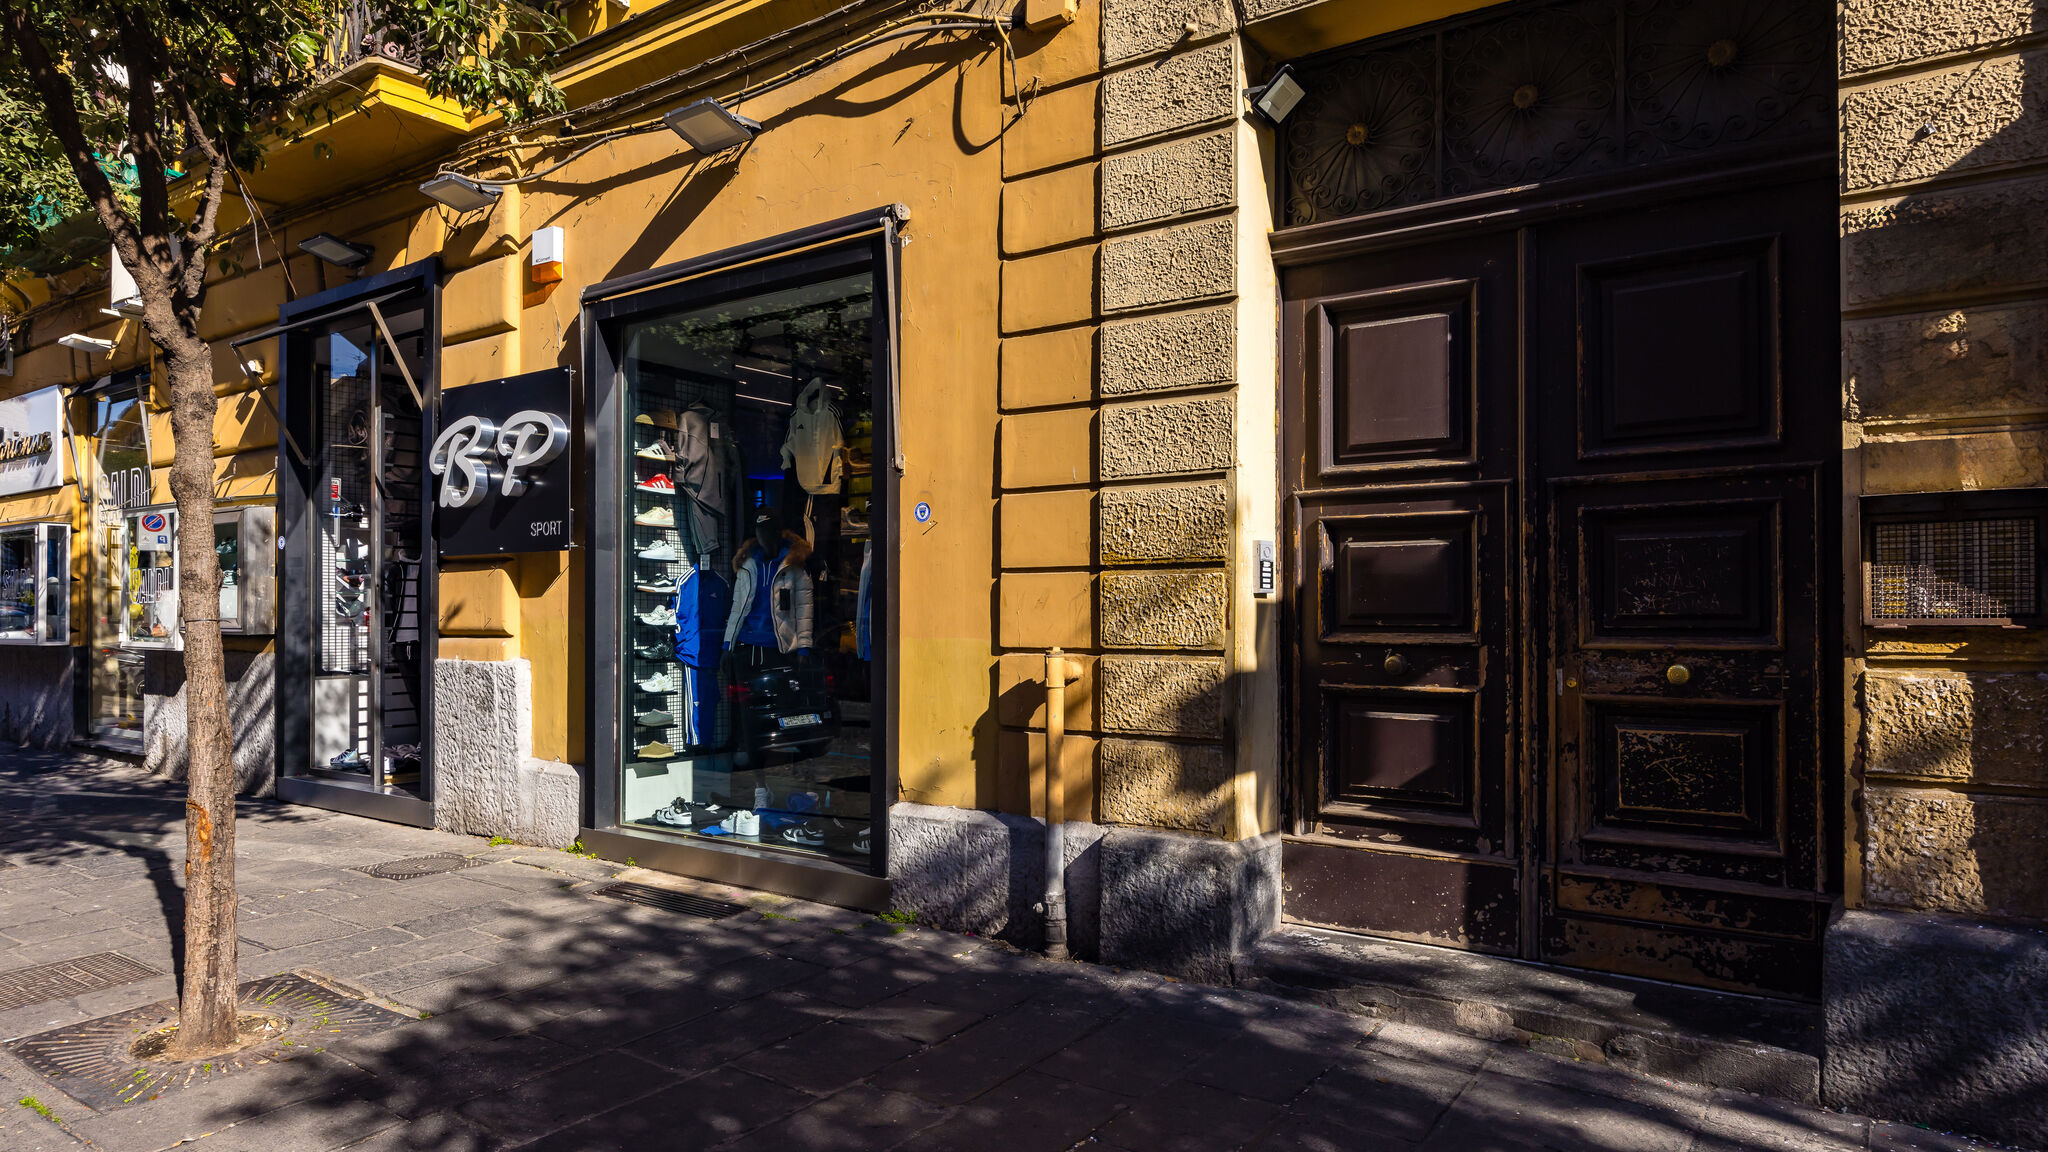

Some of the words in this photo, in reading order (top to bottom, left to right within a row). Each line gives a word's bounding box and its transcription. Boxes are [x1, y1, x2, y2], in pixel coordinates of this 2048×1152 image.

[429, 411, 567, 507] BP
[530, 520, 562, 536] SPORT
[129, 567, 170, 604] SALDI
